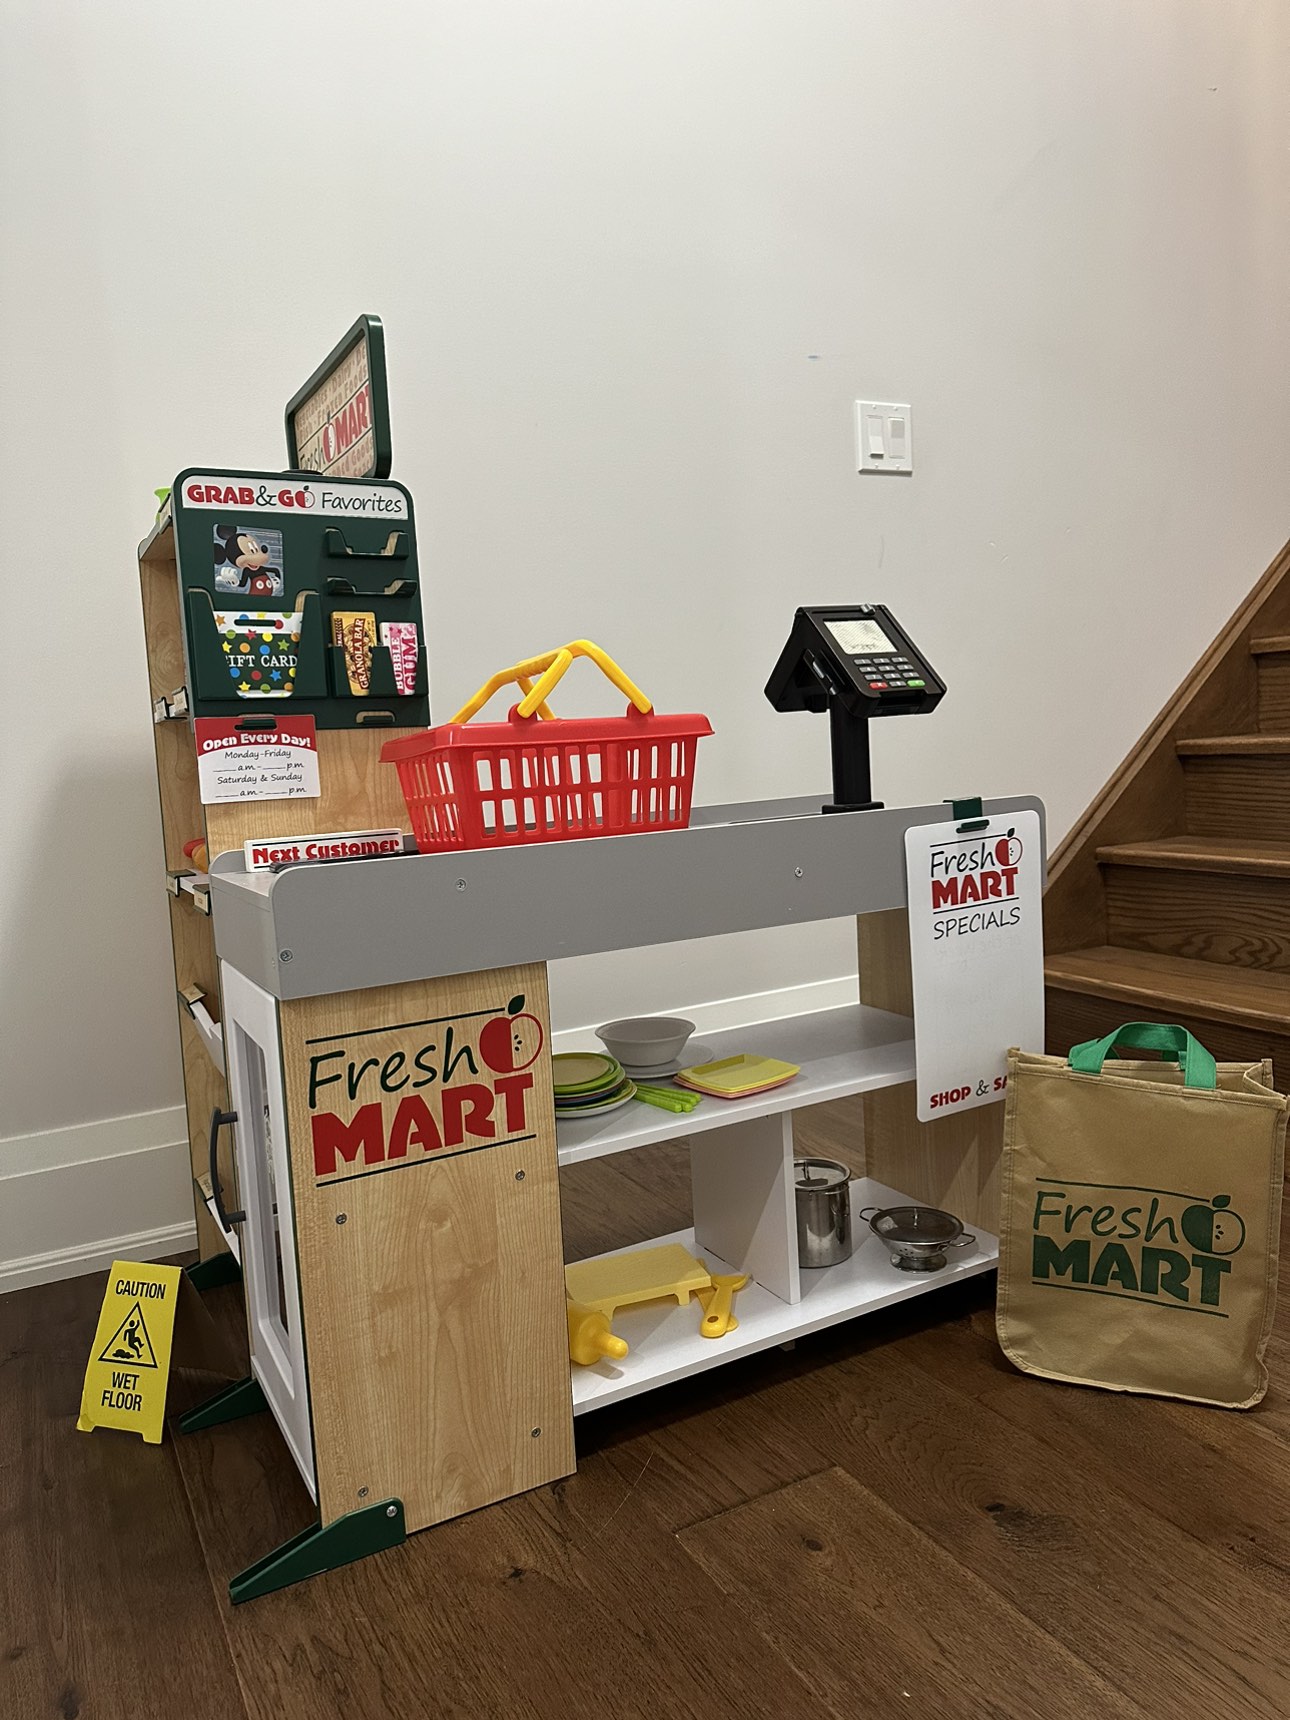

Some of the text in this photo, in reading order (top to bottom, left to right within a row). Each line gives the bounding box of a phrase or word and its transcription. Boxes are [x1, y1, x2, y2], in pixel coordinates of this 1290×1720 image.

[321, 492, 402, 513] Favorites
[225, 654, 298, 668] IFT CARD
[354, 619, 369, 689] GRANOLA BAR
[391, 637, 404, 690] BUBBLE
[402, 636, 418, 690] GUM
[202, 733, 311, 751] Open Every Day!
[217, 775, 257, 785] Saturday
[271, 773, 302, 782] Sunday
[252, 839, 399, 864] Next Customer
[931, 842, 995, 878] Fresh
[931, 867, 1018, 909] MART
[934, 907, 1020, 940] SPECIALS
[309, 1026, 479, 1109] Fresh
[930, 1086, 971, 1109] SHOP
[975, 1079, 990, 1097] &
[311, 1072, 533, 1176] MART
[1033, 1191, 1179, 1244] Fresh
[1032, 1235, 1231, 1306] MART
[115, 1279, 166, 1299] CAUTION
[112, 1371, 139, 1390] WET
[101, 1390, 142, 1411] FLOOR
